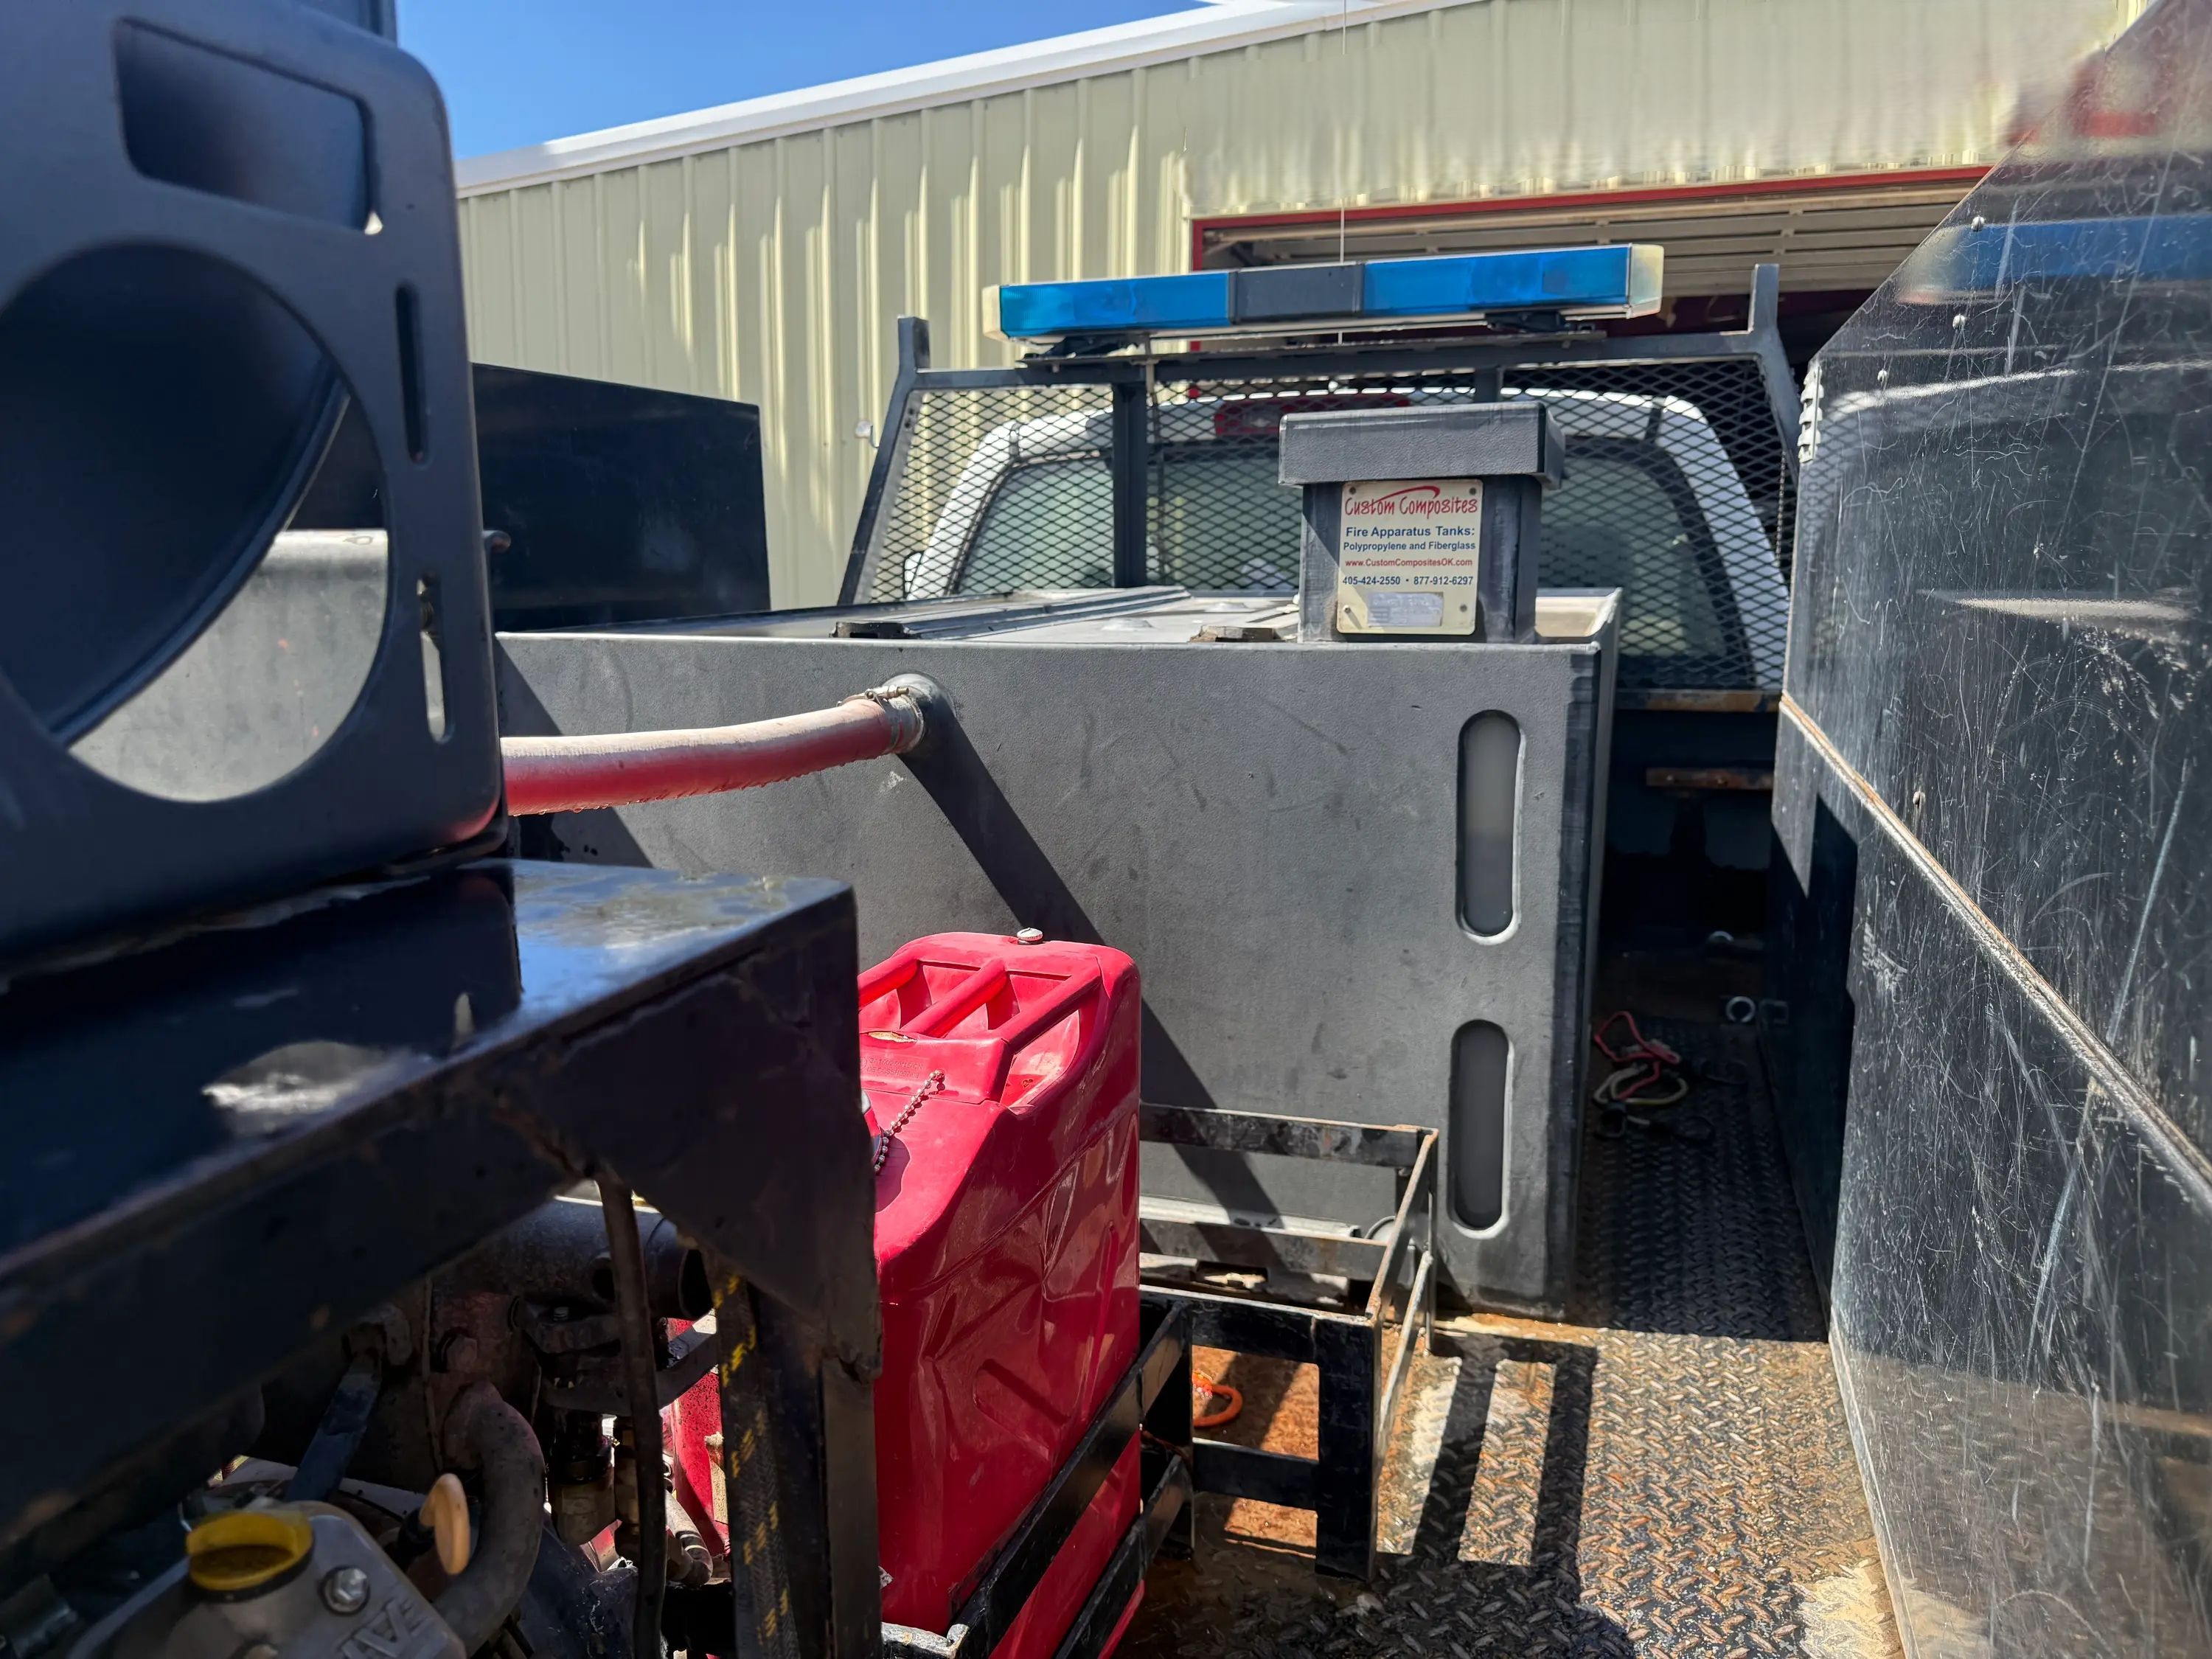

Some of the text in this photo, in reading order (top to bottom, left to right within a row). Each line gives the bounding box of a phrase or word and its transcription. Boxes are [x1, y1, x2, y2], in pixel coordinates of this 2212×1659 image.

[1345, 496, 1478, 519] Custom Composites
[1346, 526, 1475, 539] Fire Apparatus Tanks:
[1343, 541, 1475, 552] Polypropylene and Fiberglass
[1345, 558, 1472, 568] www.CustomCompositesOK.com
[1343, 577, 1473, 585] 405-424-2550 877-912-6297
